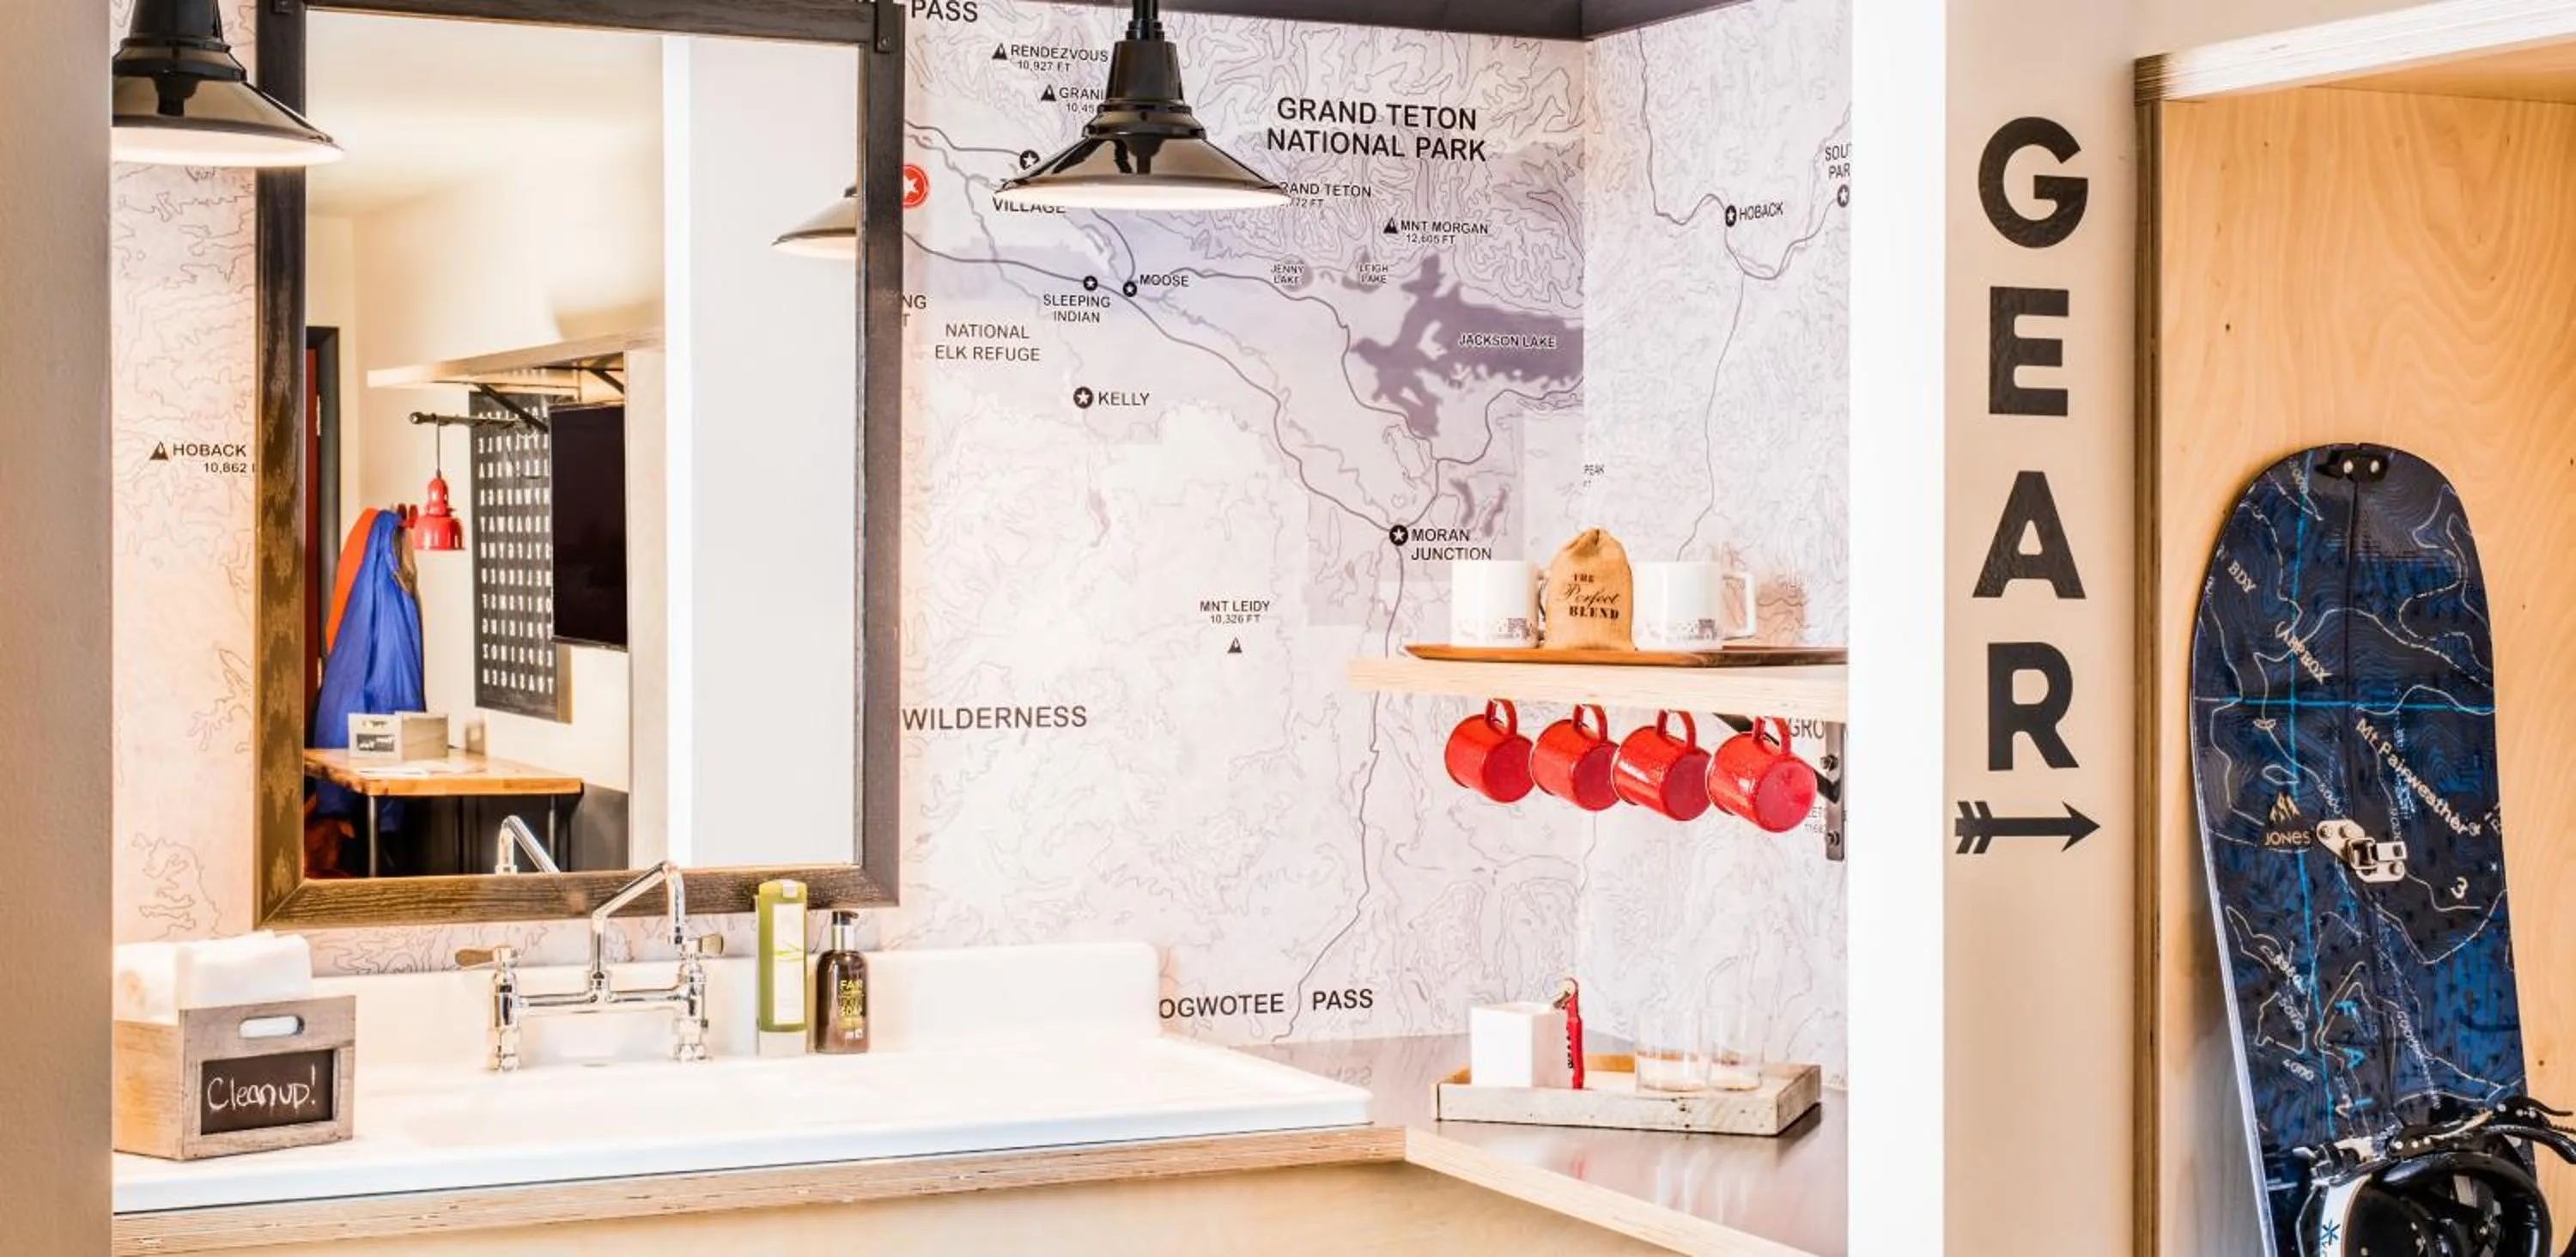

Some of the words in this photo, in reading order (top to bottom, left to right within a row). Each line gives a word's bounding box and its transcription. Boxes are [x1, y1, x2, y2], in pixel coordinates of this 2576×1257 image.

[911, 0, 978, 22] PASS
[1011, 44, 1109, 62] RENDEZVOUS
[1018, 60, 1054, 71] 10,927
[1277, 97, 1376, 124] GRAND
[1386, 104, 1477, 131] TETON
[1267, 128, 1405, 158] NATIONAL
[1416, 137, 1486, 162] PARK
[1324, 183, 1371, 198] TETON
[1739, 203, 1784, 222] HOBACK
[1400, 220, 1427, 232] MNT
[1432, 221, 1489, 235] MORGAN
[1271, 264, 1304, 274] JENNY
[1139, 274, 1189, 288] MOOSE
[1043, 294, 1111, 309] SLEEPING
[1054, 310, 1101, 324] INDIAN
[945, 324, 1030, 340] NATIONAL
[1459, 334, 1520, 348] JACKSON
[1523, 336, 1557, 349] LAKE
[935, 344, 968, 360] ELK
[973, 346, 1041, 362] REFUGE
[1098, 392, 1151, 407] KELLY
[173, 444, 246, 457] HOBACK
[1411, 528, 1470, 542] MORAN
[1411, 547, 1492, 562] JUNCTION
[2227, 561, 2257, 593] BDY
[1200, 600, 1229, 612] MNT
[1232, 600, 1270, 612] LEIDY
[1569, 606, 1619, 619] BLEND
[902, 706, 1088, 732] WILDERNESS
[1159, 993, 1284, 1019] OGWOTEE
[1312, 989, 1374, 1011] PASS
